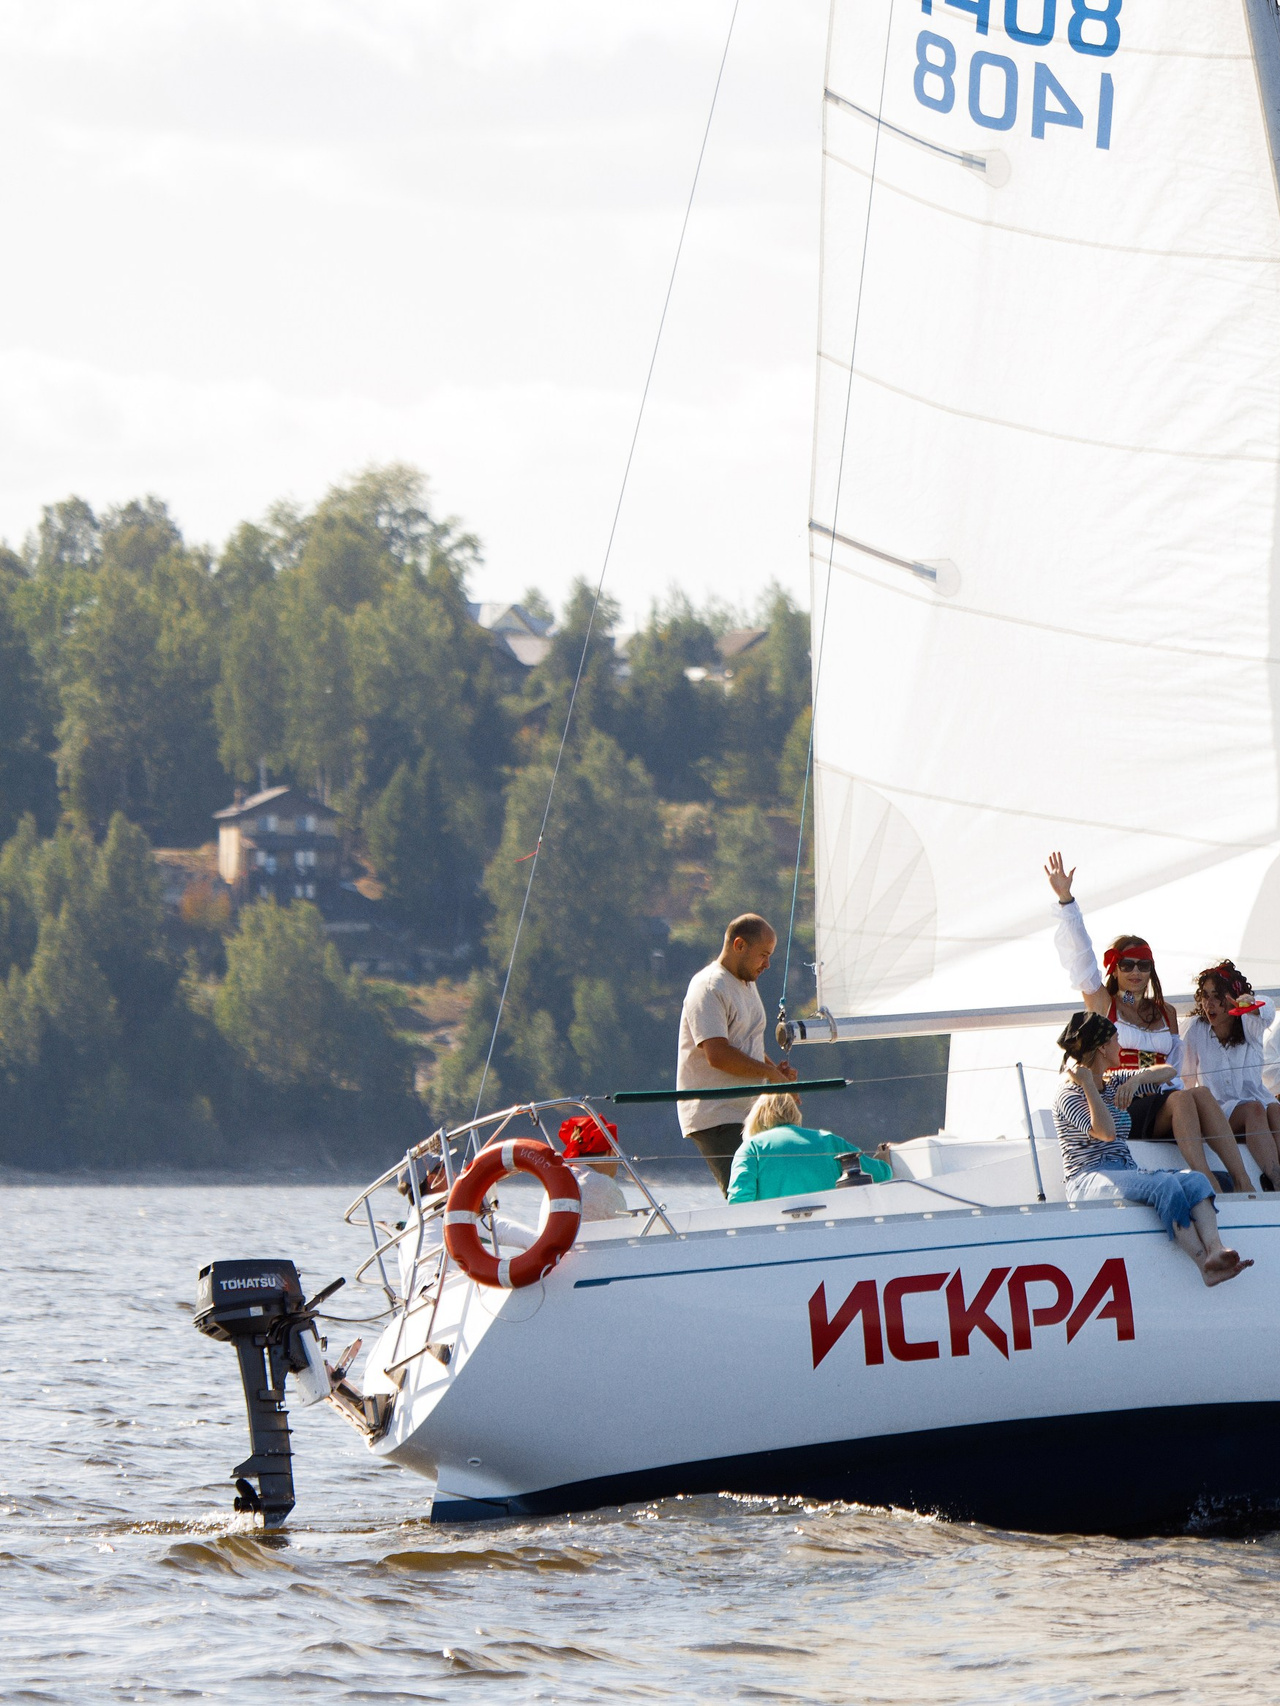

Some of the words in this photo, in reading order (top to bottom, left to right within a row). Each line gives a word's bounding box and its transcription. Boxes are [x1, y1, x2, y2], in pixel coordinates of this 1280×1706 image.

[920, 0, 1123, 58] 08
[220, 1277, 276, 1291] TOHATSU
[808, 1257, 1136, 1371] ИСКРА
